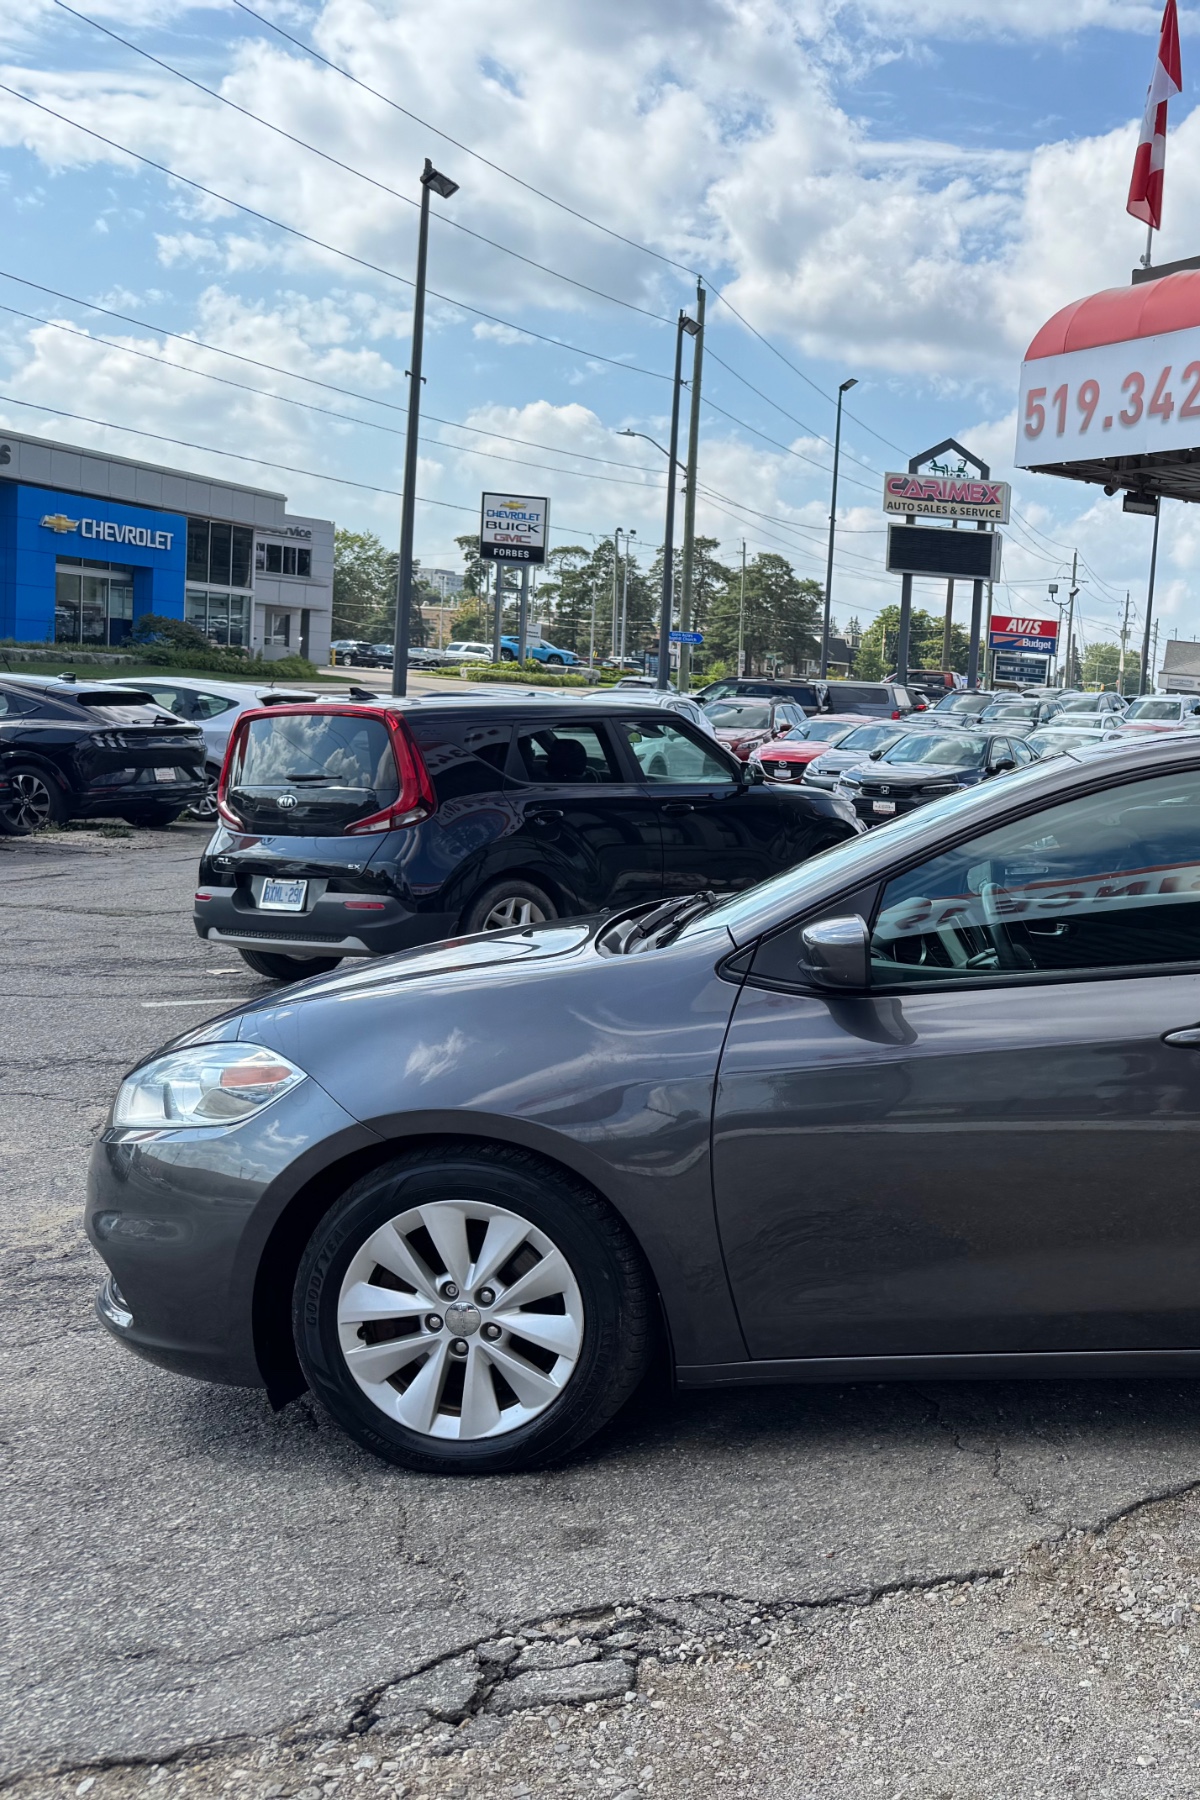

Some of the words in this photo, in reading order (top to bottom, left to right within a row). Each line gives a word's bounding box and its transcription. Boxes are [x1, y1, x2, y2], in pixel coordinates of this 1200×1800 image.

[886, 477, 1004, 504] CARIMEX
[486, 509, 541, 521] CHEVROLET
[886, 501, 915, 512] AUTO
[916, 503, 948, 514] SALES
[949, 507, 958, 515] &
[959, 507, 1001, 518] SERVICE
[485, 520, 541, 534] BUICK
[81, 518, 174, 551] CHEVROLET
[494, 533, 532, 544] GMC
[493, 548, 530, 559] FORBES
[1005, 618, 1042, 635] AVIS
[1022, 638, 1052, 651] Budget
[279, 796, 295, 808] KIA
[305, 1222, 348, 1326] GOODYEA
